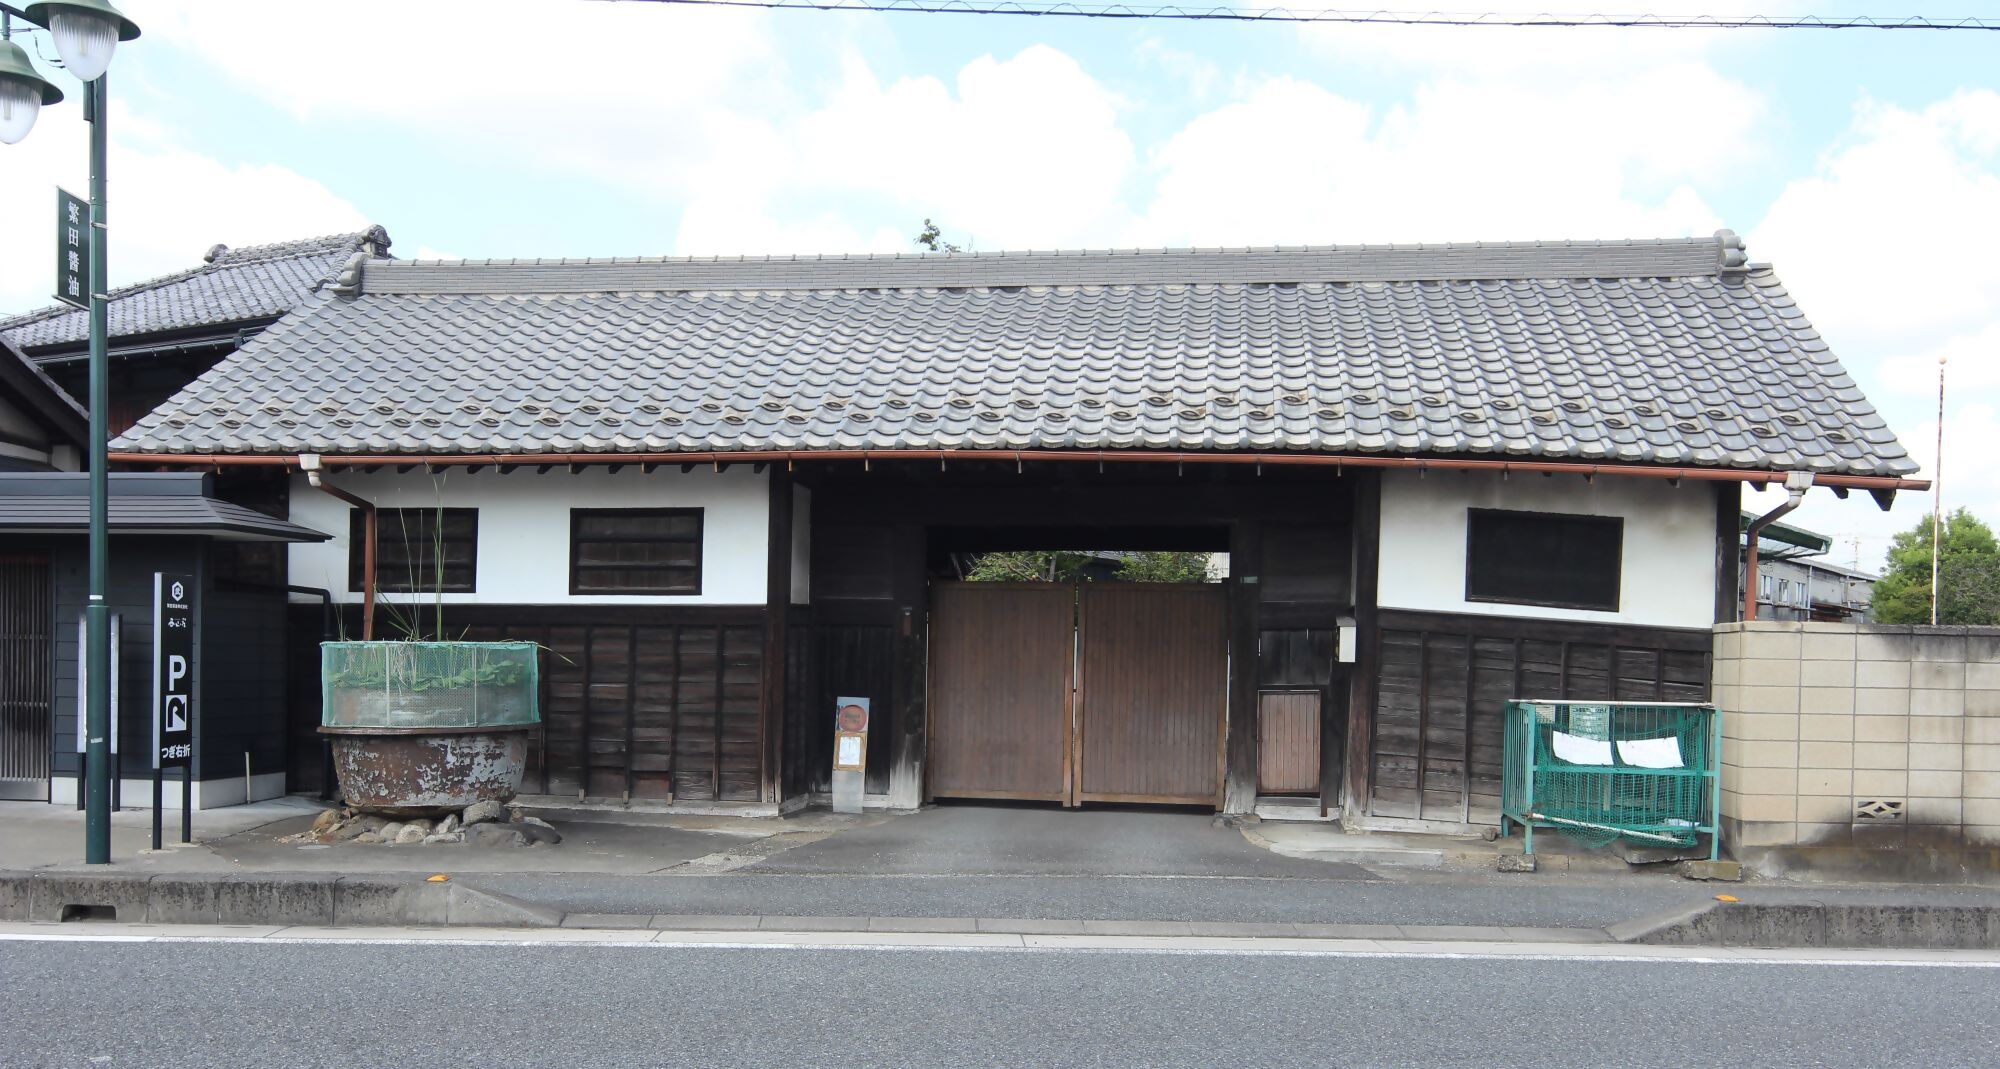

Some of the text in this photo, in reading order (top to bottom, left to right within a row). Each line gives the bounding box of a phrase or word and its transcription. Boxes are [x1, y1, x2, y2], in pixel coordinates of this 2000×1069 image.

[168, 654, 187, 691] P
[161, 743, 191, 759] つぎ右折
